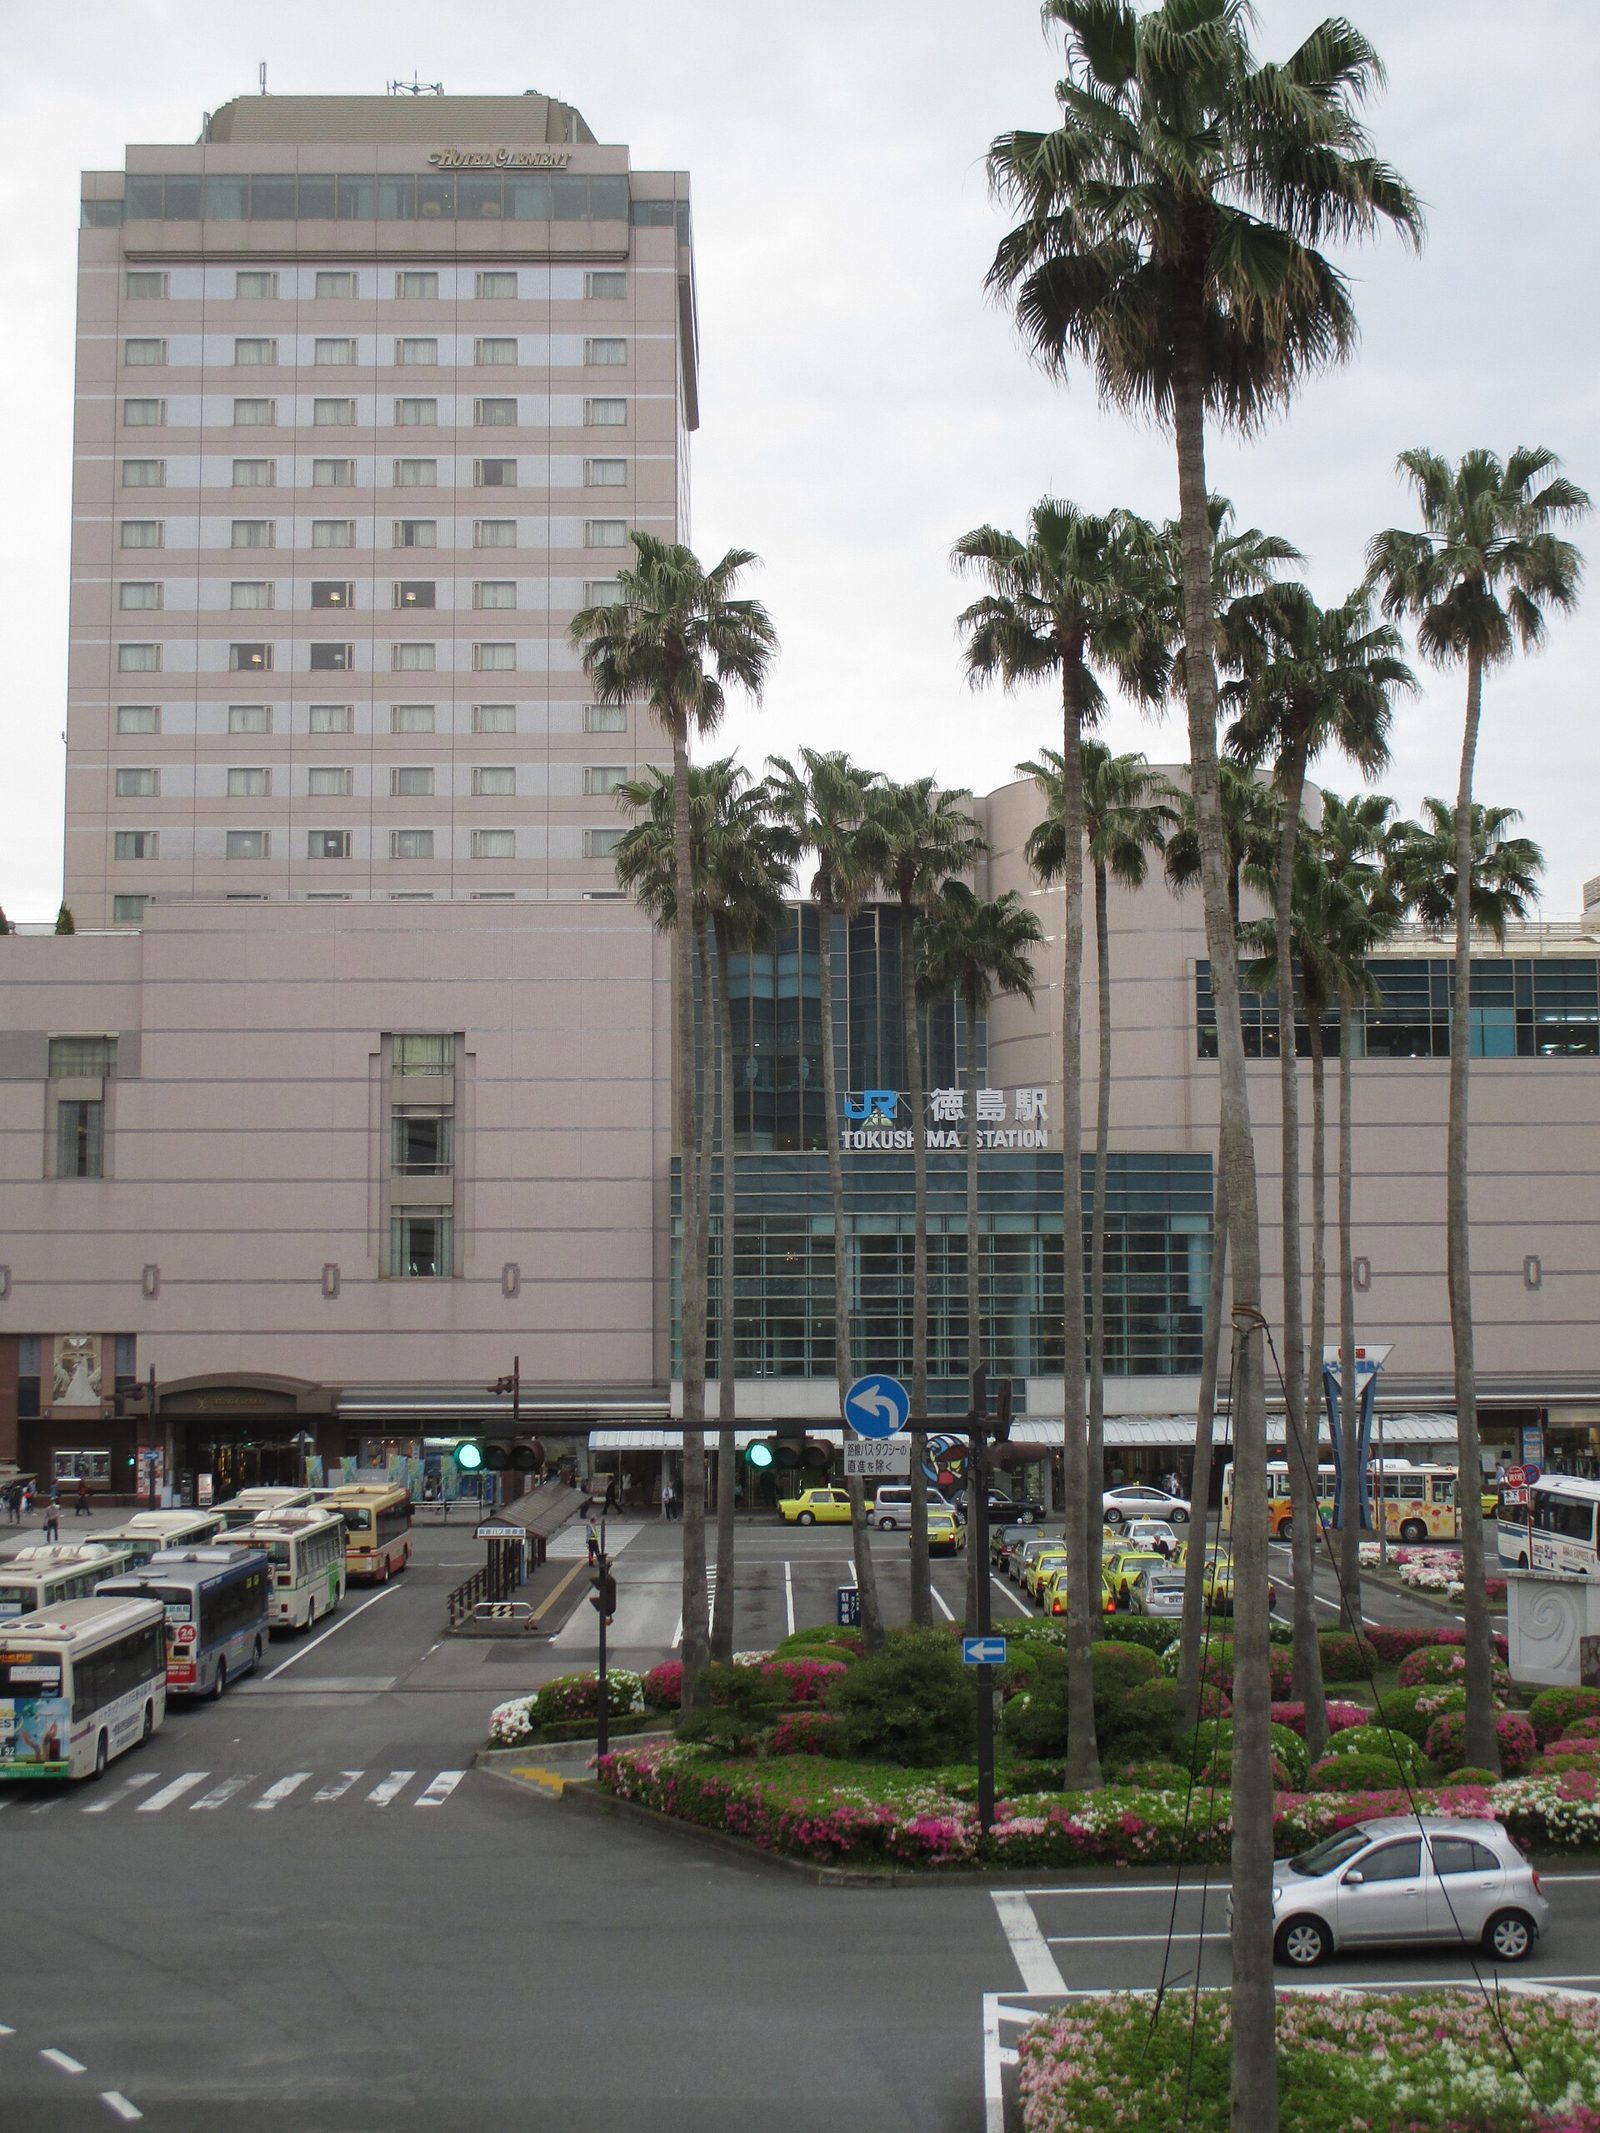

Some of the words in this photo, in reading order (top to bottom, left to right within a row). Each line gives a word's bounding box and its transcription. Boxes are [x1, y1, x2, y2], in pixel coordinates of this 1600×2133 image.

[844, 1089, 897, 1120] JR
[930, 1087, 1049, 1122] 徳島駅
[841, 1130, 961, 1150] TOKUSHMA
[847, 1459, 892, 1473] 直進を除く
